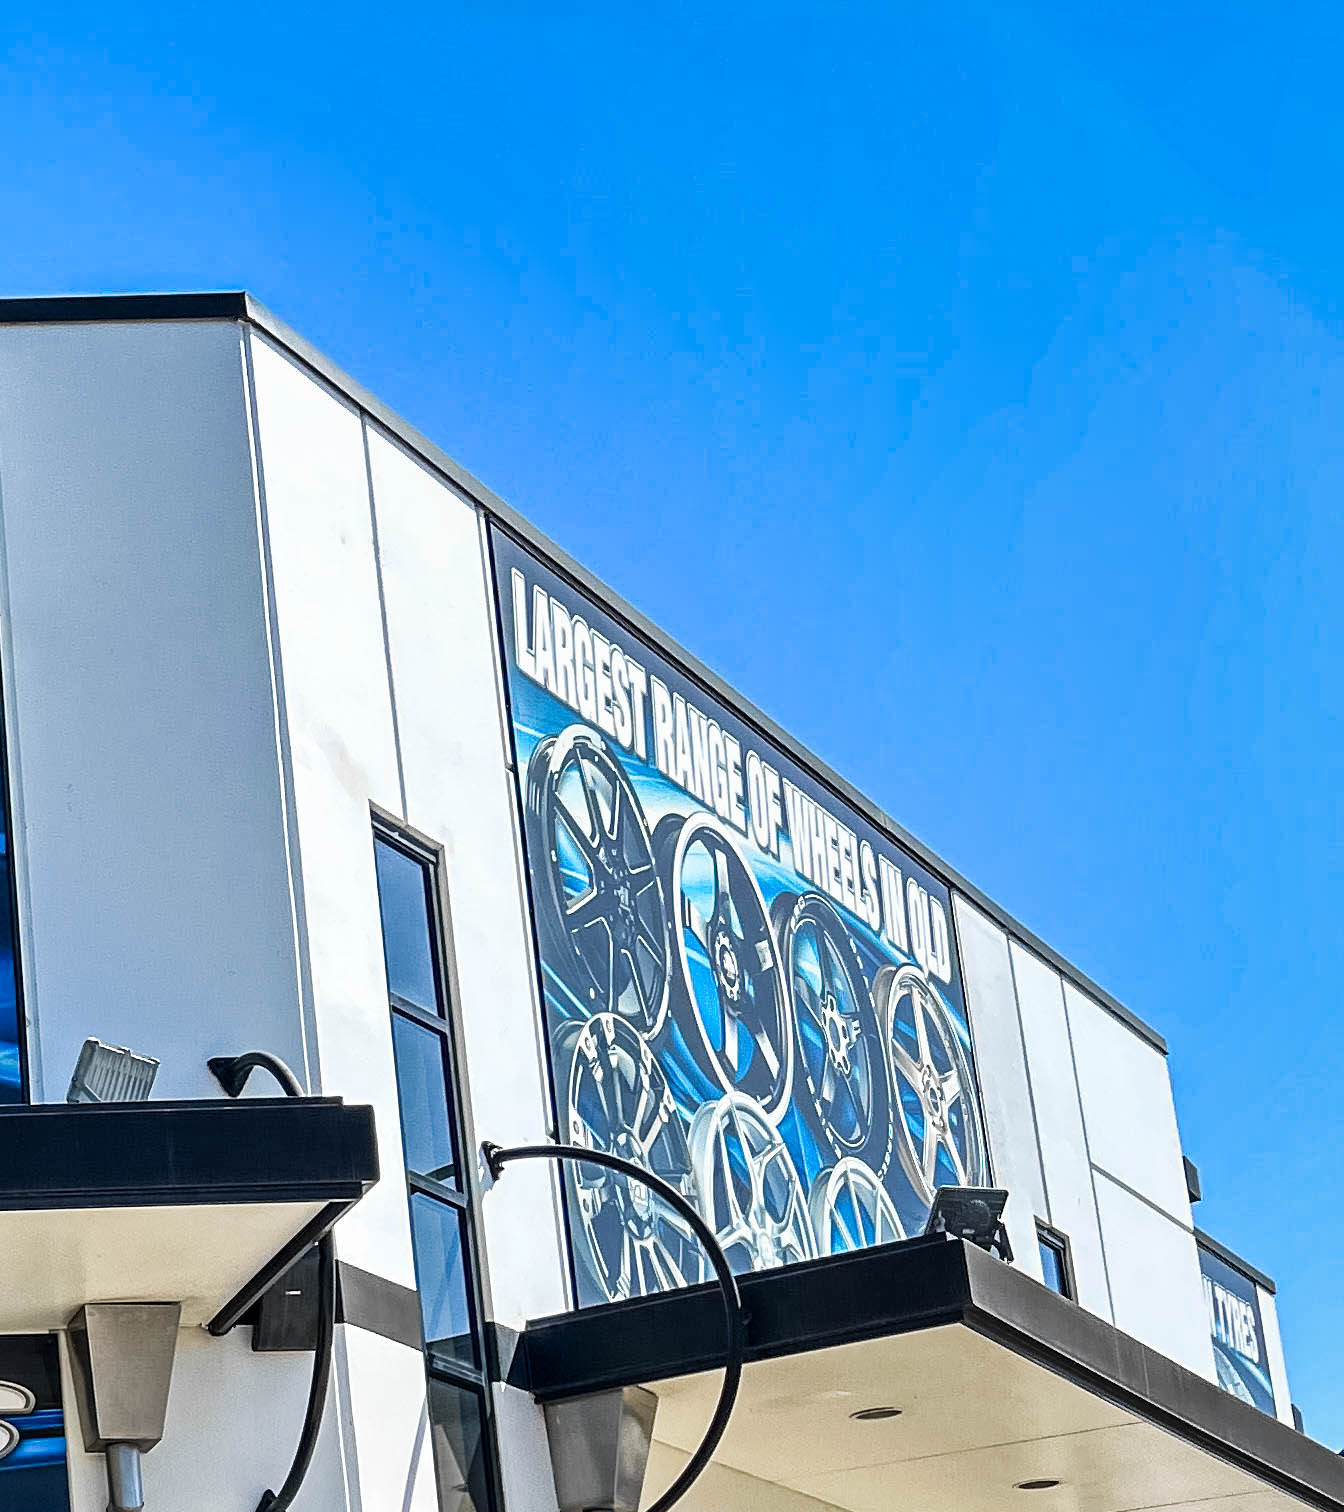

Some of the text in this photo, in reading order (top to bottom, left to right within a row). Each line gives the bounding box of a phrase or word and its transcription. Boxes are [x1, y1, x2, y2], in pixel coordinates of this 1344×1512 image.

[511, 567, 648, 761] LARGEST
[650, 675, 748, 838] RANGE
[746, 749, 782, 861] OF
[782, 777, 882, 932] WHEELS
[878, 854, 910, 955] IN
[1213, 1281, 1260, 1364] TYRES
